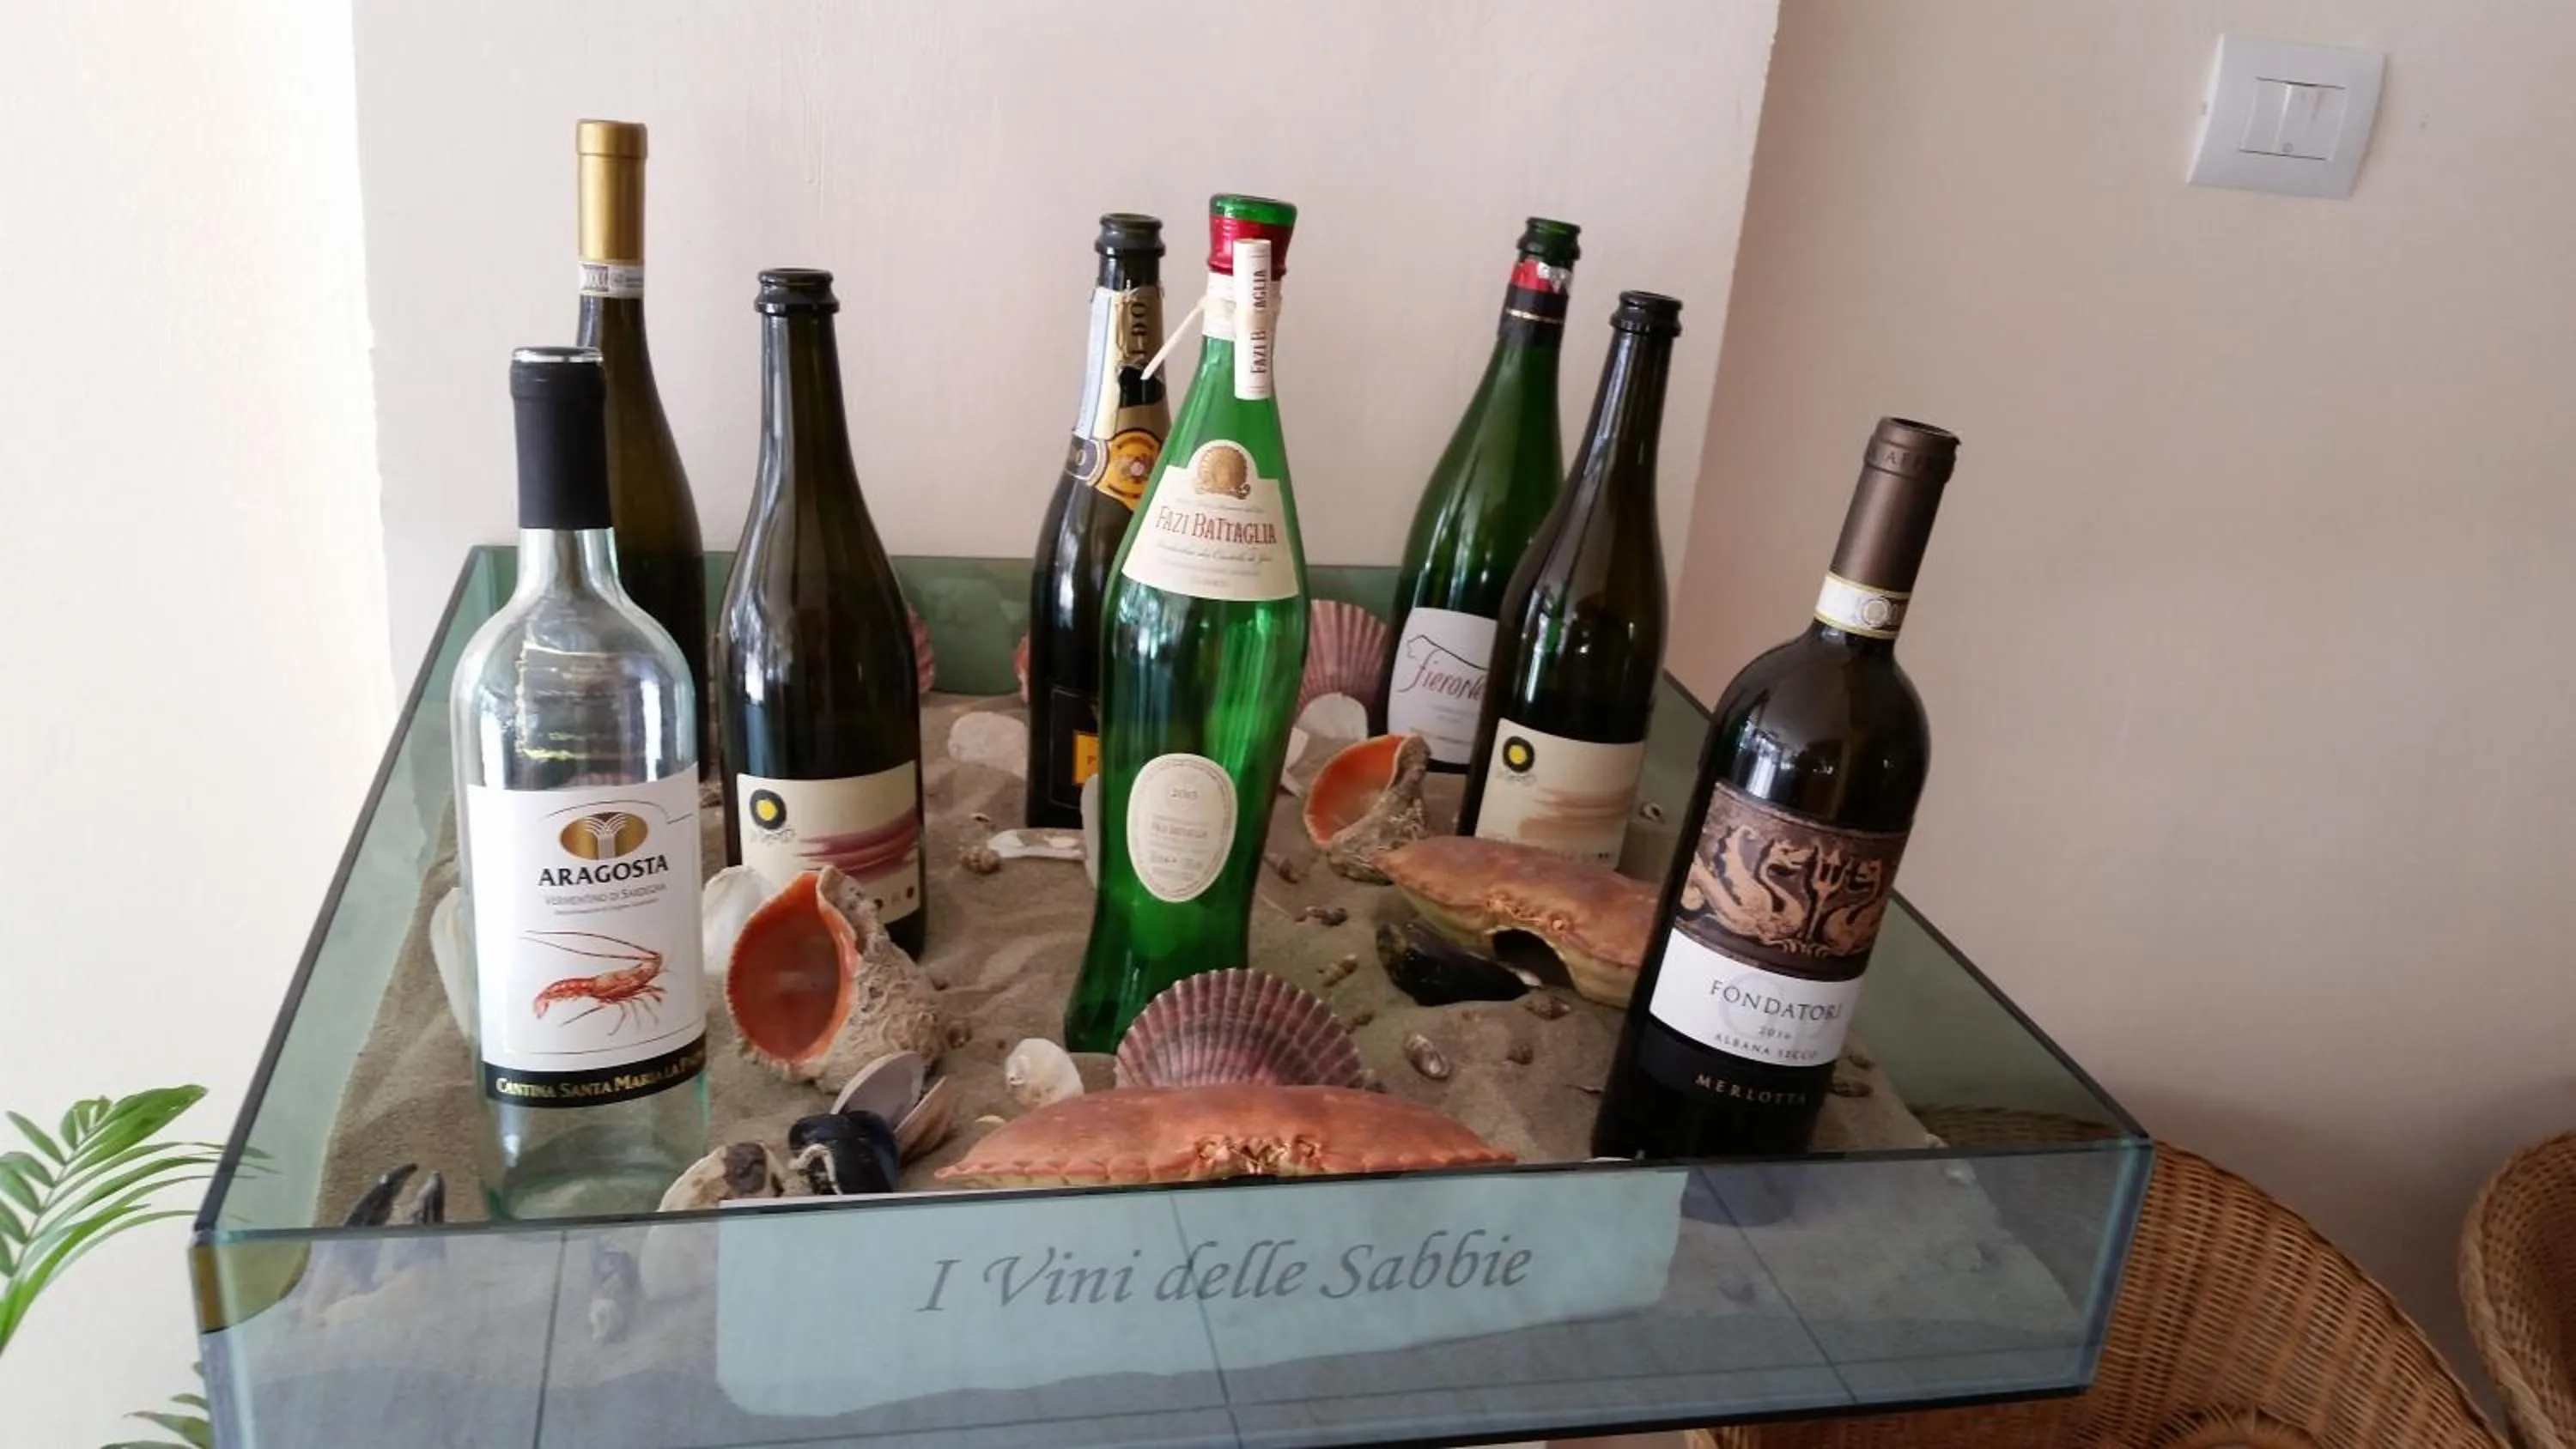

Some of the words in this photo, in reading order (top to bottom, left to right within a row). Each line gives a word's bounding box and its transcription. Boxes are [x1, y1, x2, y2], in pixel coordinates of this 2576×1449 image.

[1156, 505, 1188, 534] FAZI
[1191, 512, 1278, 544] BATTAGLIA
[538, 854, 670, 887] ARAGOSTA
[1714, 1034, 1771, 1055] ALBANA
[495, 1076, 558, 1098] CANTINA
[560, 1080, 611, 1097] SANTA
[914, 1258, 963, 1313] I
[981, 1246, 1143, 1307] Vini
[1153, 1239, 1309, 1303] delle
[1317, 1228, 1535, 1300] Sabbie
